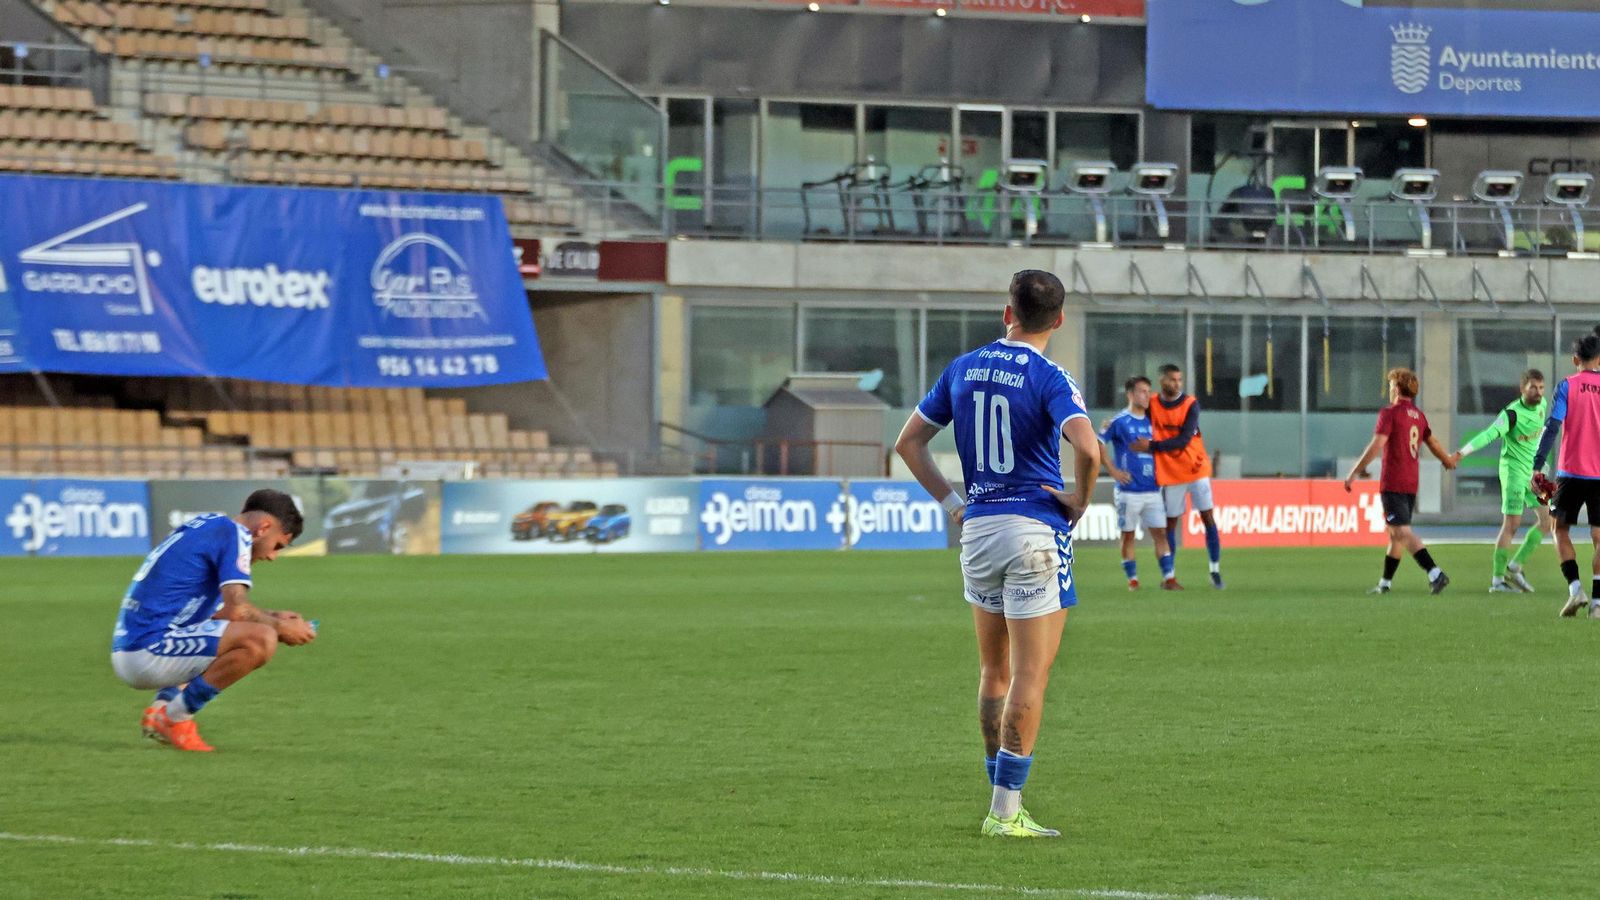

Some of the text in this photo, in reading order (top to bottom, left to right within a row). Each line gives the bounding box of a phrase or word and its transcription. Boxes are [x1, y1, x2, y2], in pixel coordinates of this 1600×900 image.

[1438, 72, 1522, 94] Deportes
[192, 264, 330, 310] eurotex
[964, 368, 1025, 389] SERGIO GARCÍA
[972, 391, 1015, 474] 10
[1408, 424, 1420, 460] 8
[712, 492, 817, 545] Beiman
